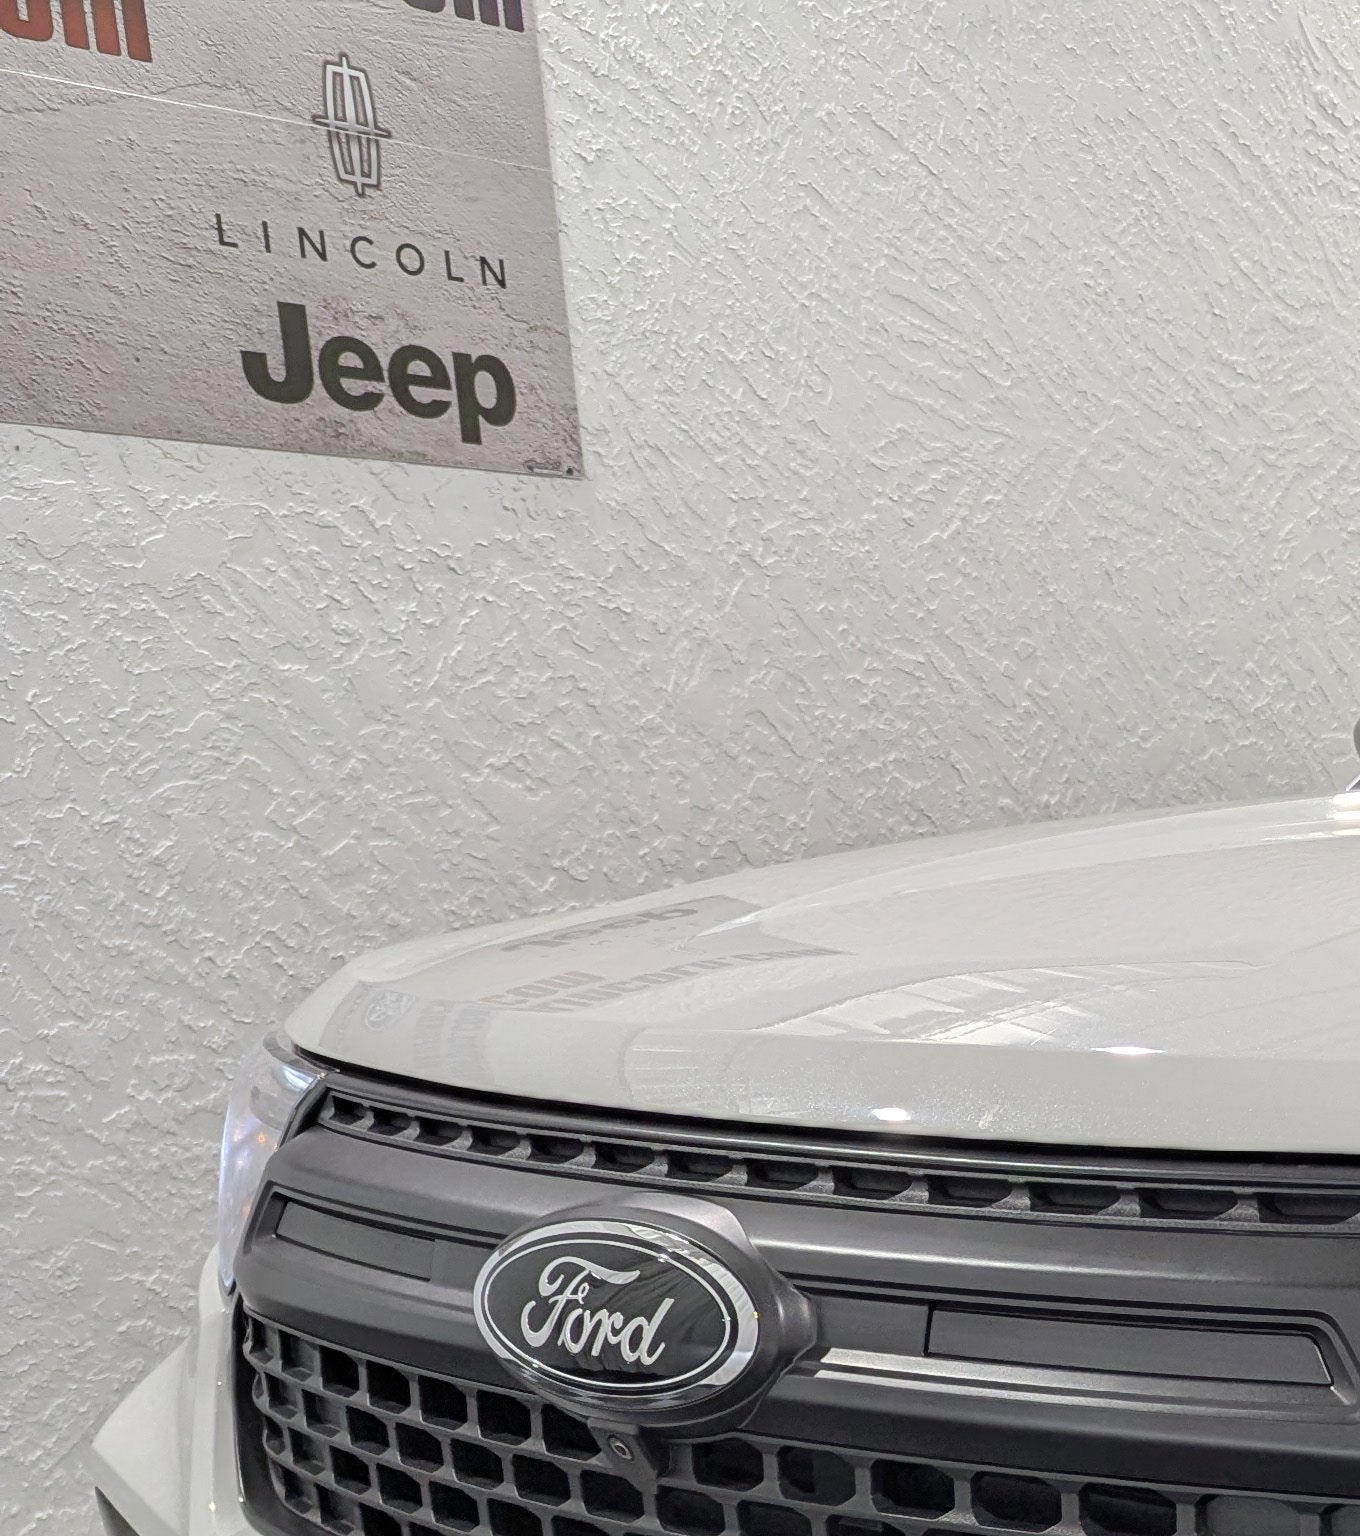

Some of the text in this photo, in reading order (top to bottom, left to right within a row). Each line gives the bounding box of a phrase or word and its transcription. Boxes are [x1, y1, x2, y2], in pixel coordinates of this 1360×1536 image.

[215, 213, 507, 289] LINCOLN
[240, 300, 516, 445] Jeep
[521, 1255, 675, 1366] Ford
